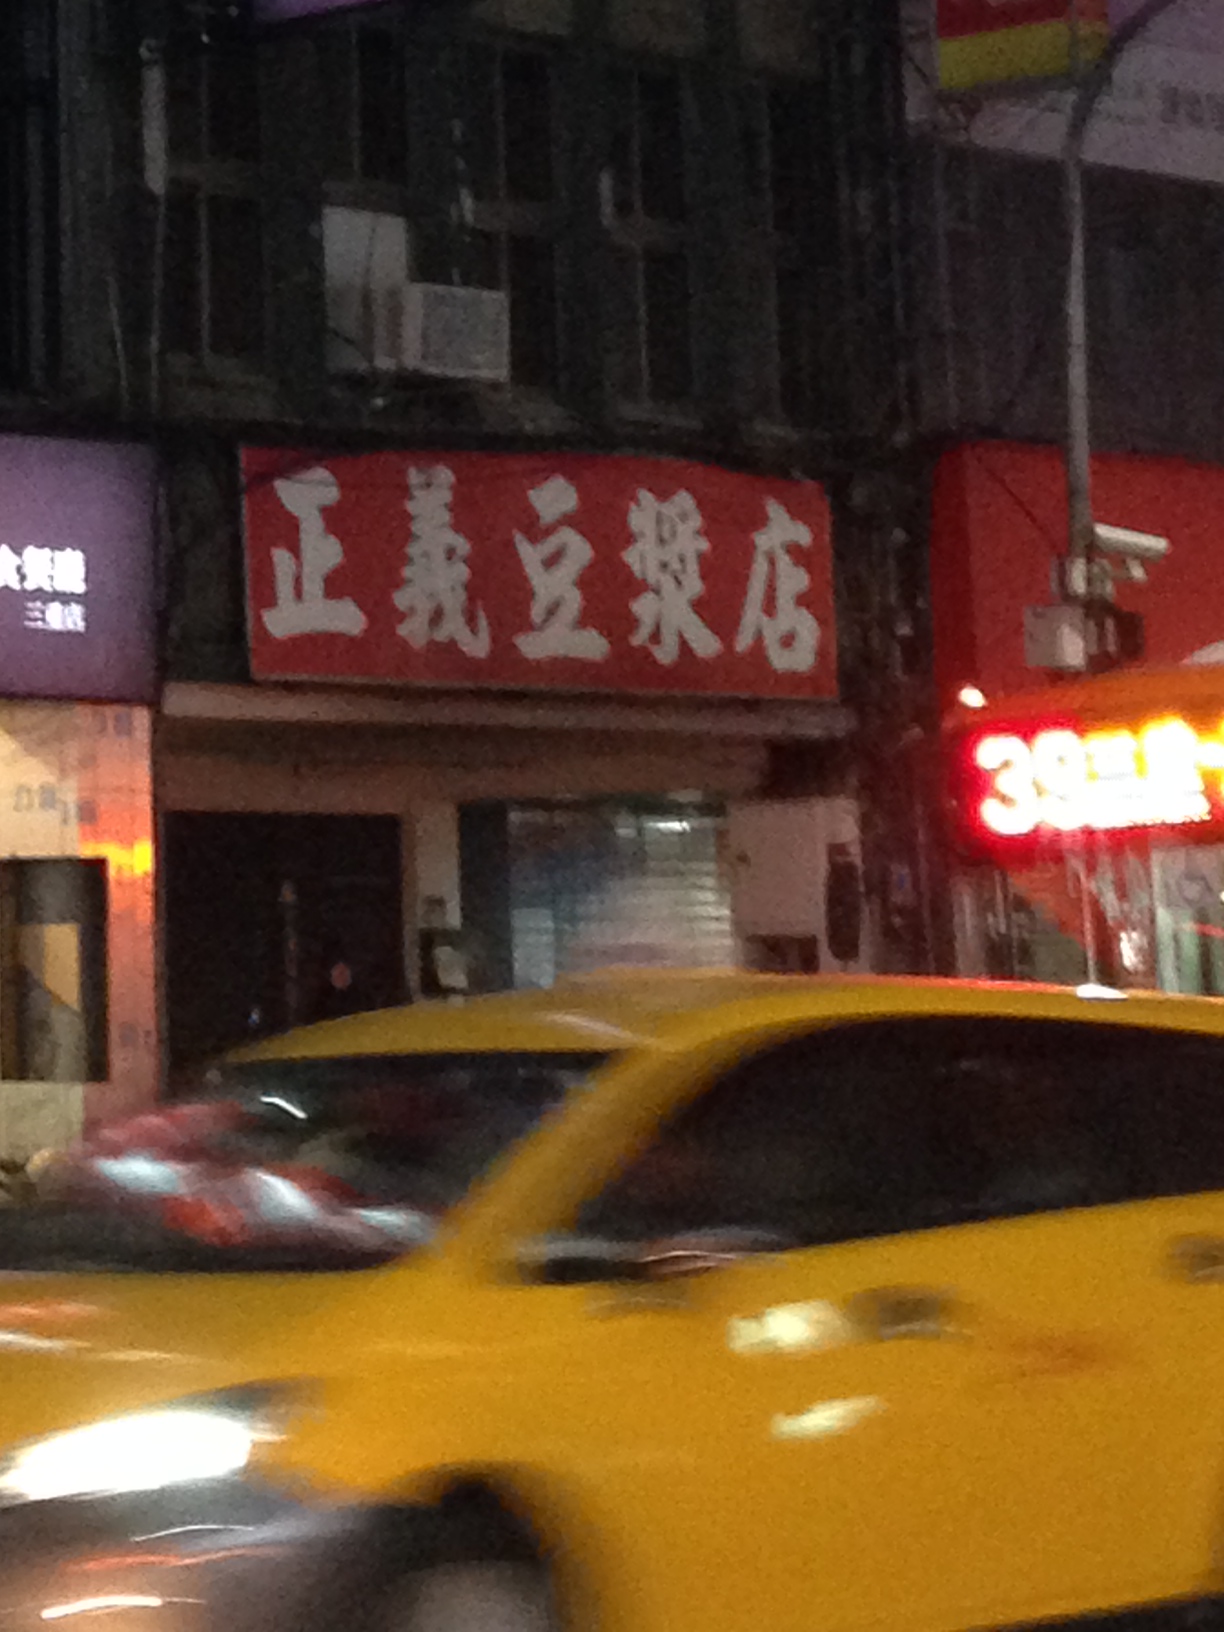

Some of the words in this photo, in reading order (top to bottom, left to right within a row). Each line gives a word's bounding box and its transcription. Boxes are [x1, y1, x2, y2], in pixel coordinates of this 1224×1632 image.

[261, 466, 822, 672] 正義豆漿店
